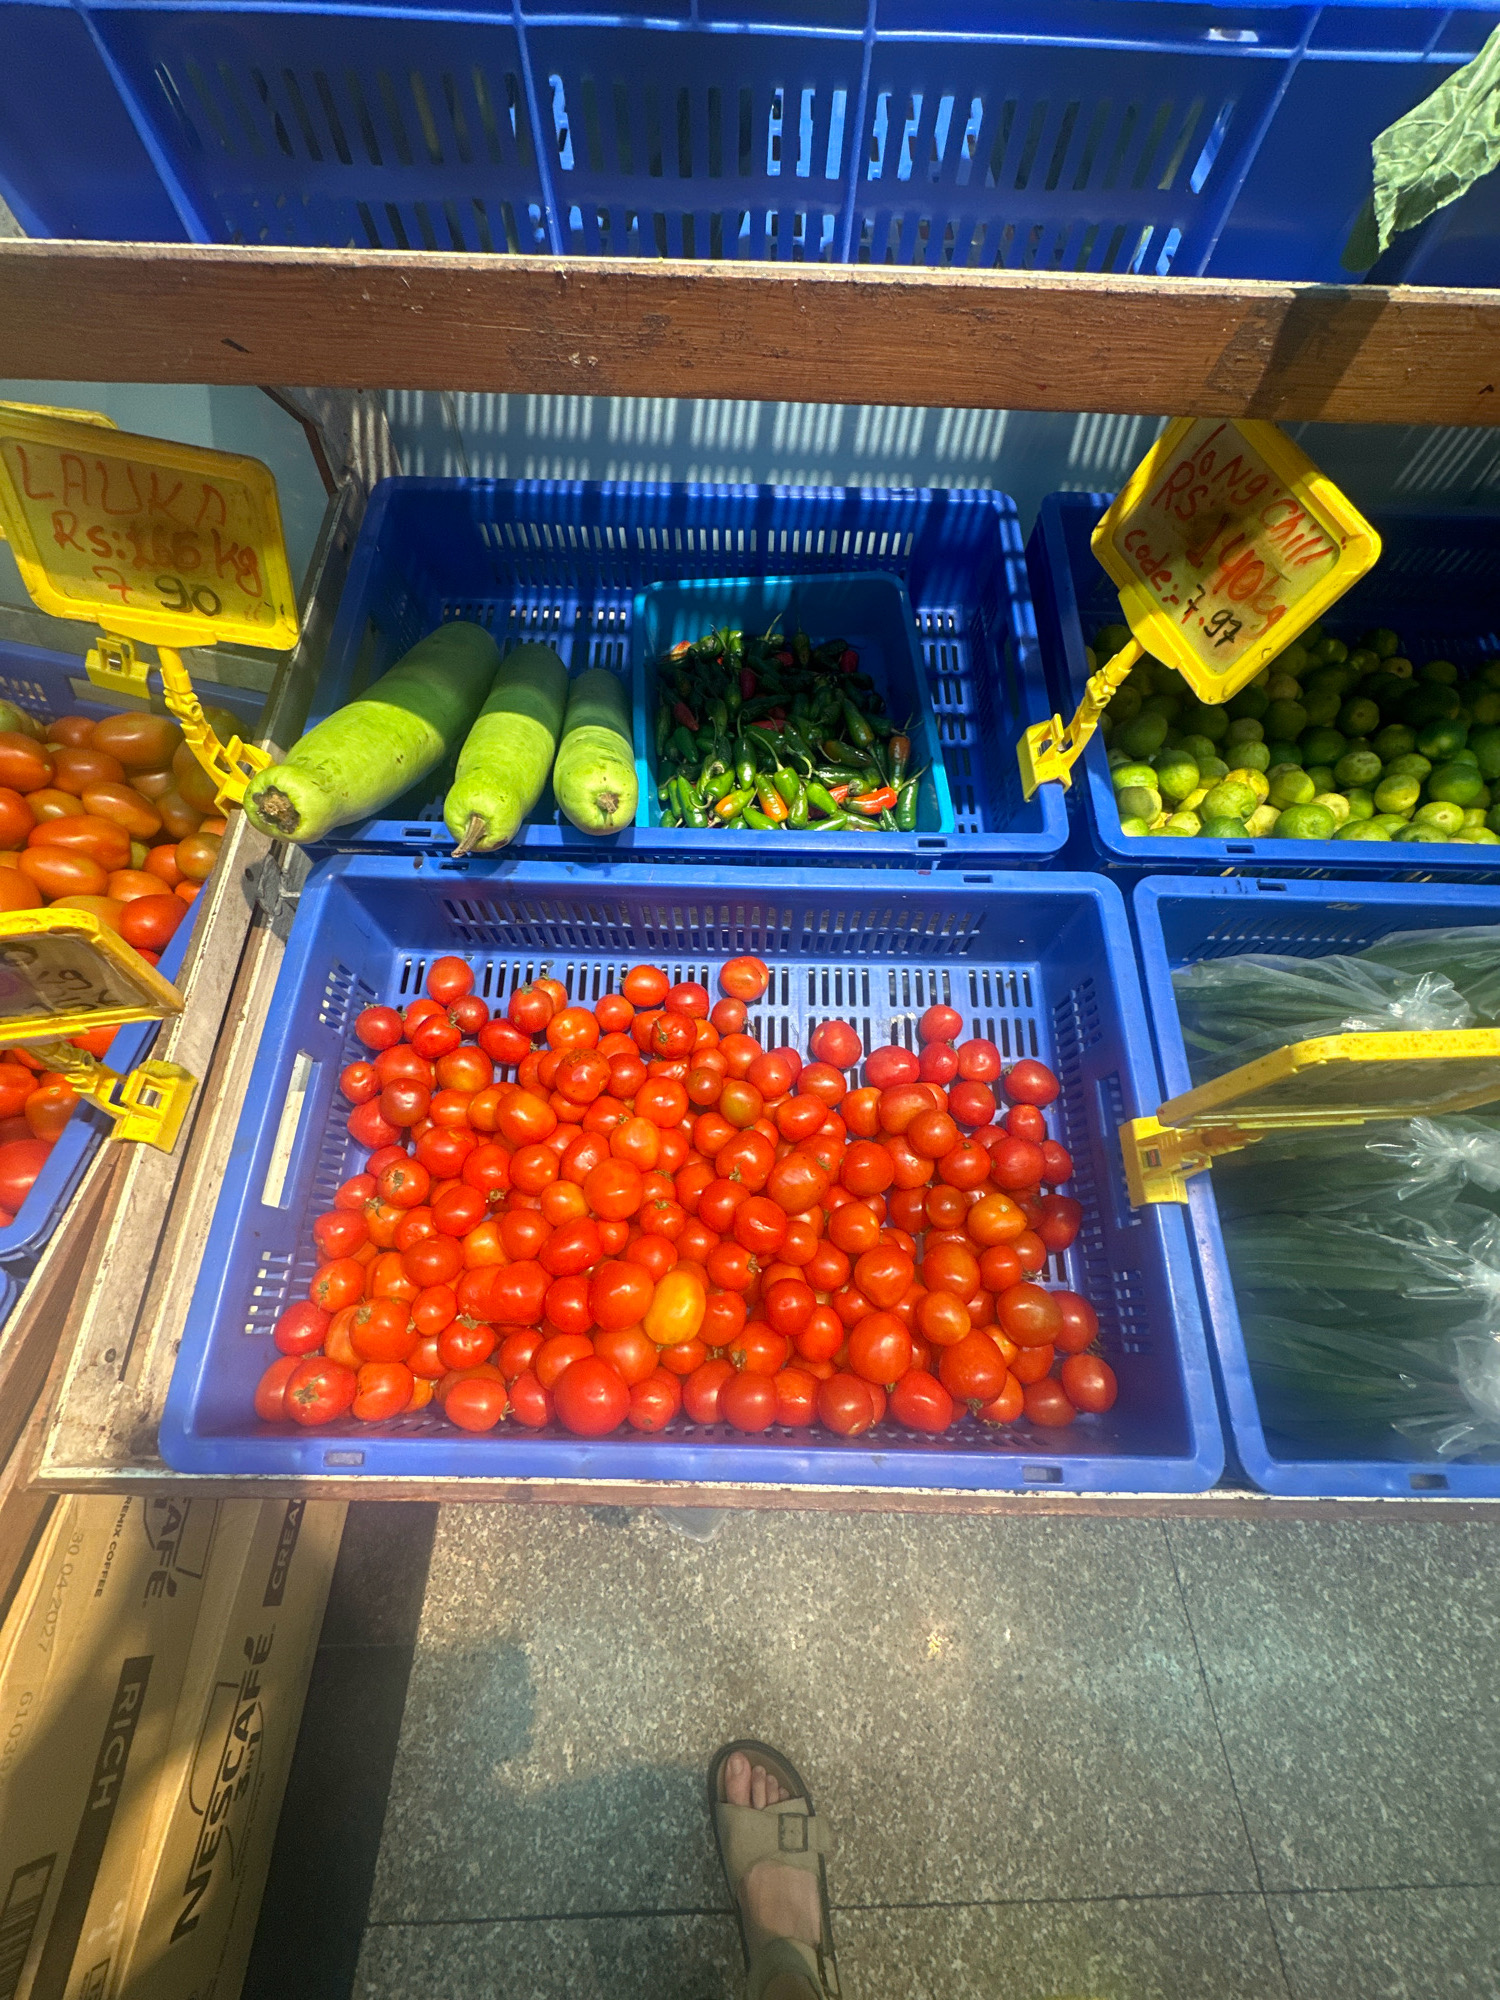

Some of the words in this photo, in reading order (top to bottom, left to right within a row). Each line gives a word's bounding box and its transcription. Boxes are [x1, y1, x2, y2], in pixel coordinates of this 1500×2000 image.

[113, 1496, 132, 1537] REMIX
[272, 1499, 302, 1590] CREA
[94, 1541, 117, 1598] COFFEE
[92, 1682, 141, 1810] RICH
